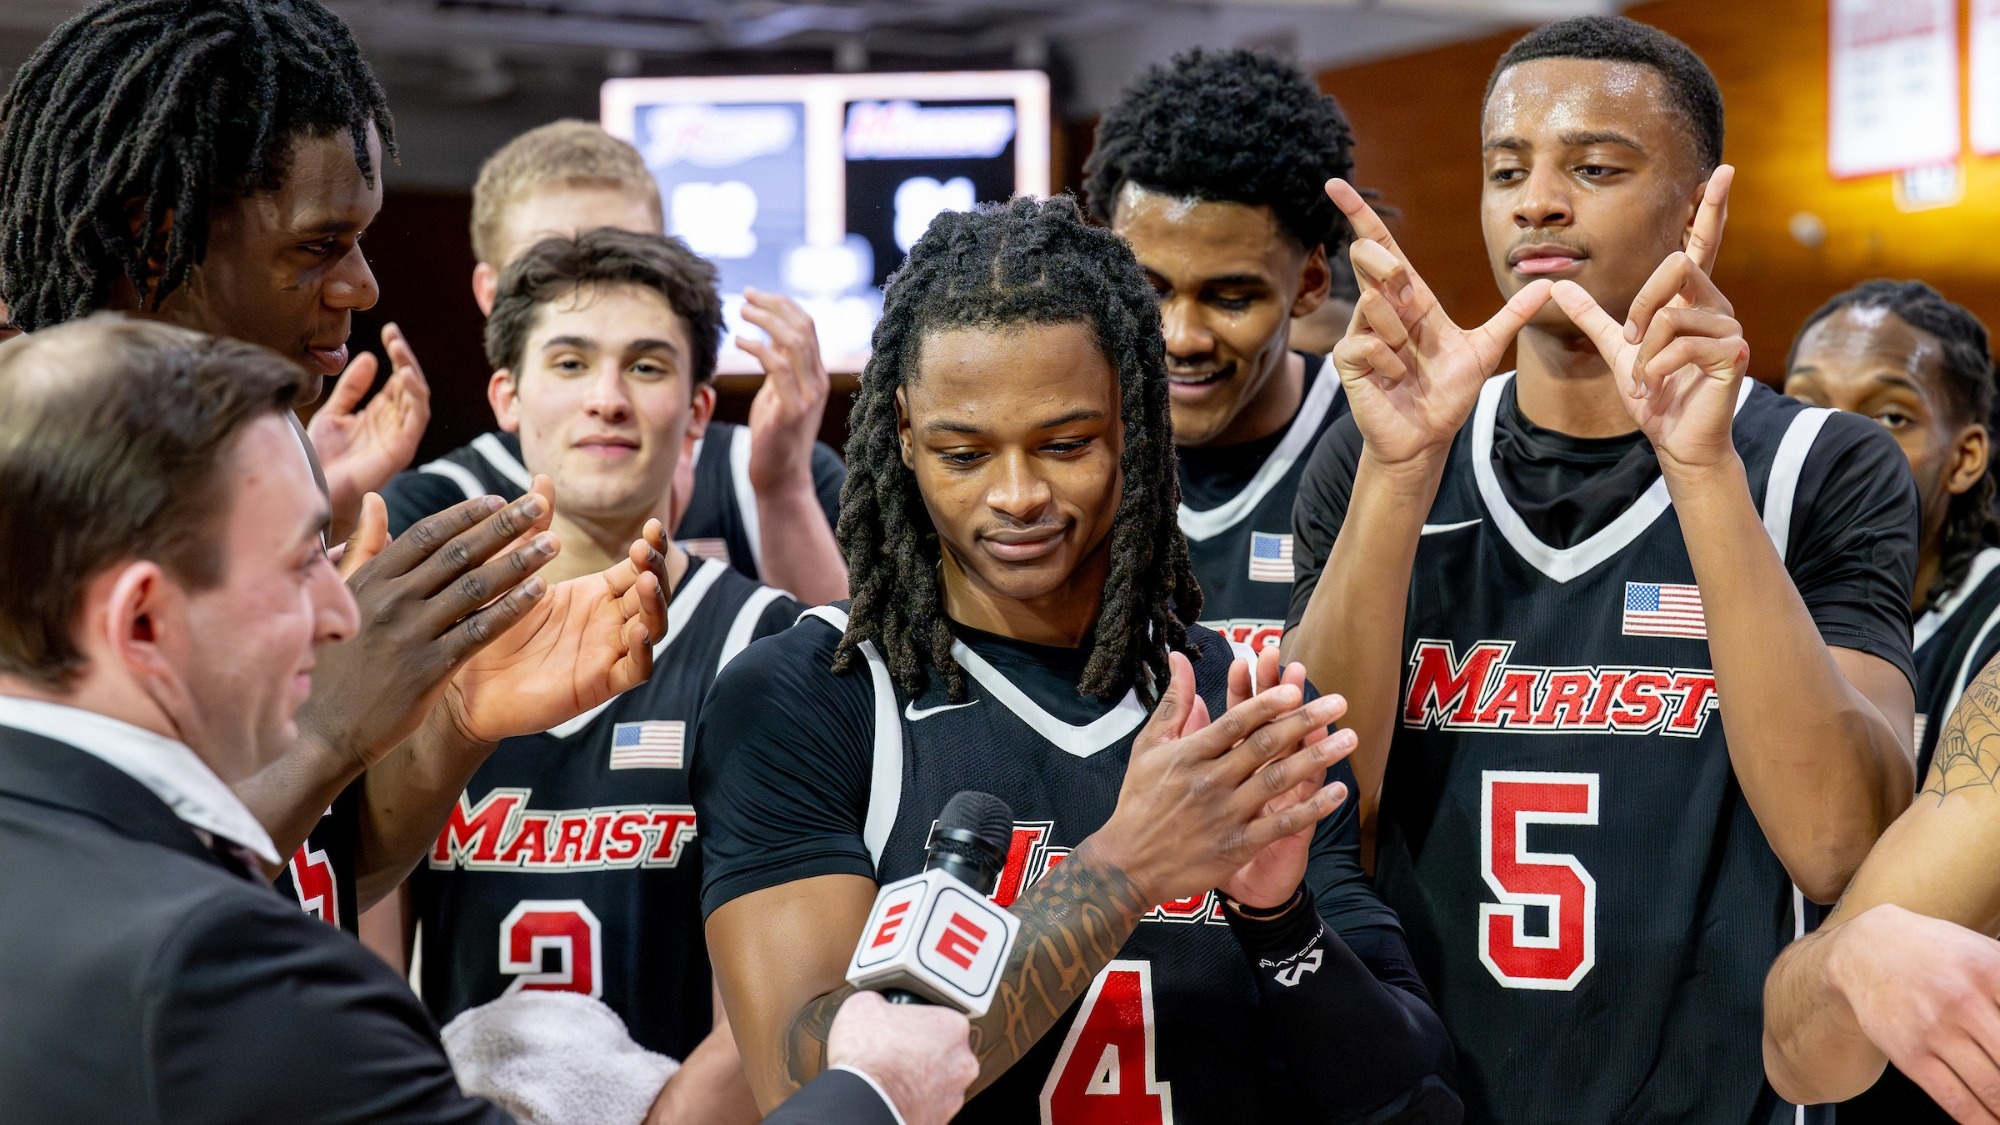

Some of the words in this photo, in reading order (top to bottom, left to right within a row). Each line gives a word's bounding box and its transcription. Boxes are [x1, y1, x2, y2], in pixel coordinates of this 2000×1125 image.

[1403, 638, 1719, 739] MARIST
[429, 787, 697, 873] MARIST
[1479, 770, 1600, 991] 5
[935, 912, 988, 971] E
[1040, 959, 1172, 1125] 4
